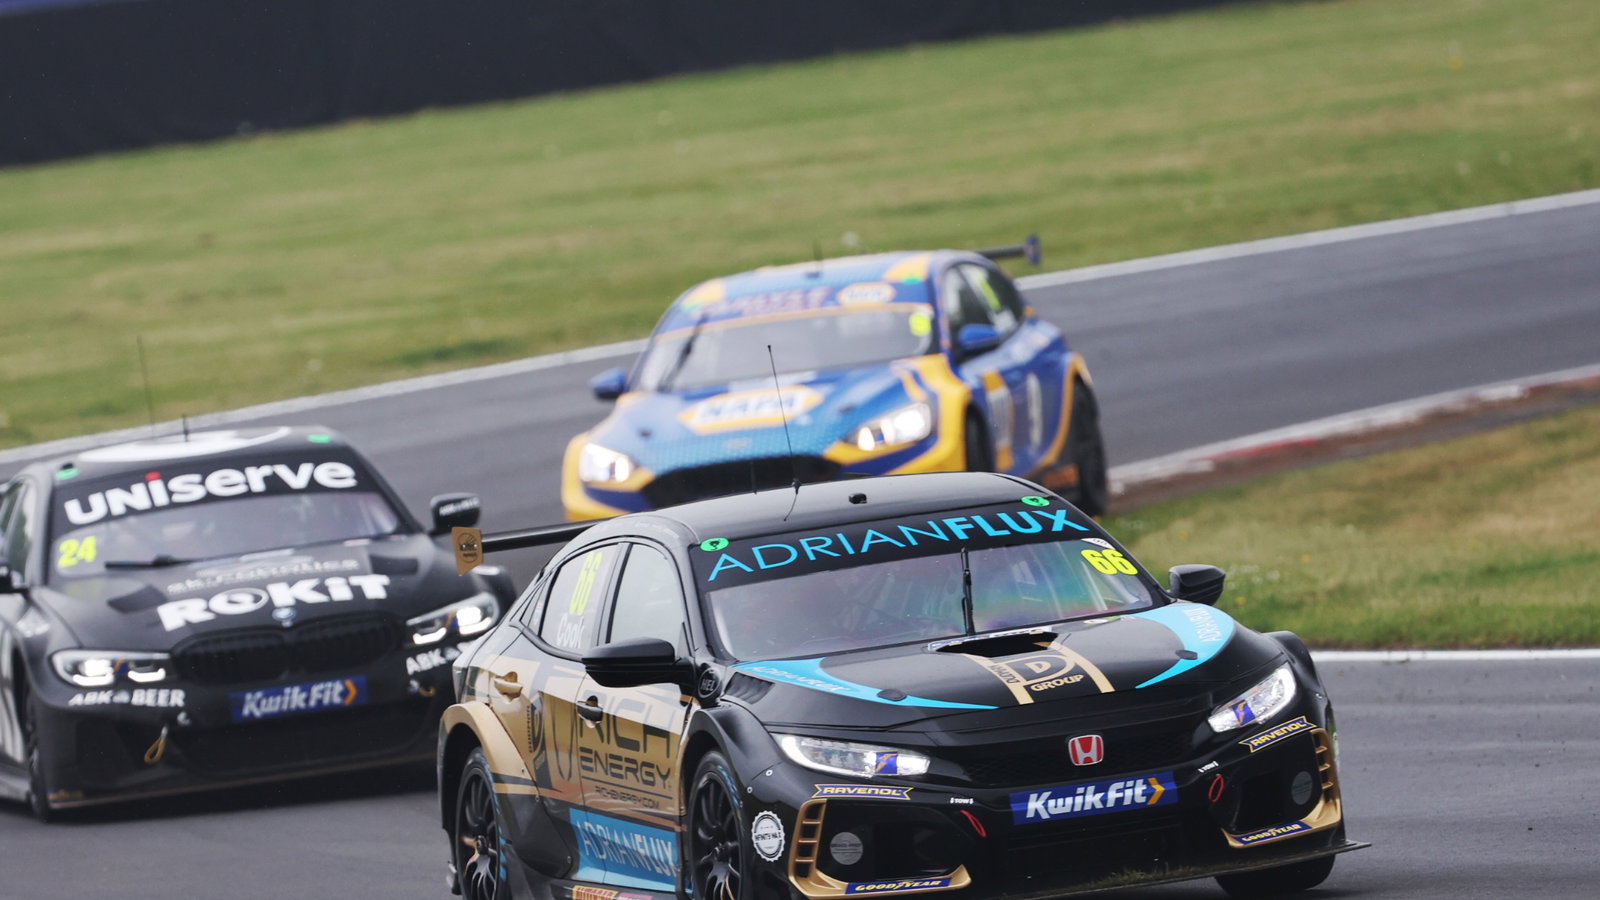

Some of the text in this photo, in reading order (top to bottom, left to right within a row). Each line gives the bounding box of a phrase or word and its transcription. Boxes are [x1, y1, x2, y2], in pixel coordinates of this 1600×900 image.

[57, 536, 97, 568] 24
[1081, 549, 1139, 575] 66
[406, 648, 447, 675] ABK
[1030, 674, 1085, 692] GROUP
[68, 688, 186, 707] ABK BEER
[1250, 721, 1307, 747] RAVENOL
[579, 746, 671, 790] ENERGY
[823, 786, 903, 796] RAVENOL
[1242, 823, 1302, 842] GOODYEAR
[855, 880, 942, 892] GOODYEAR
